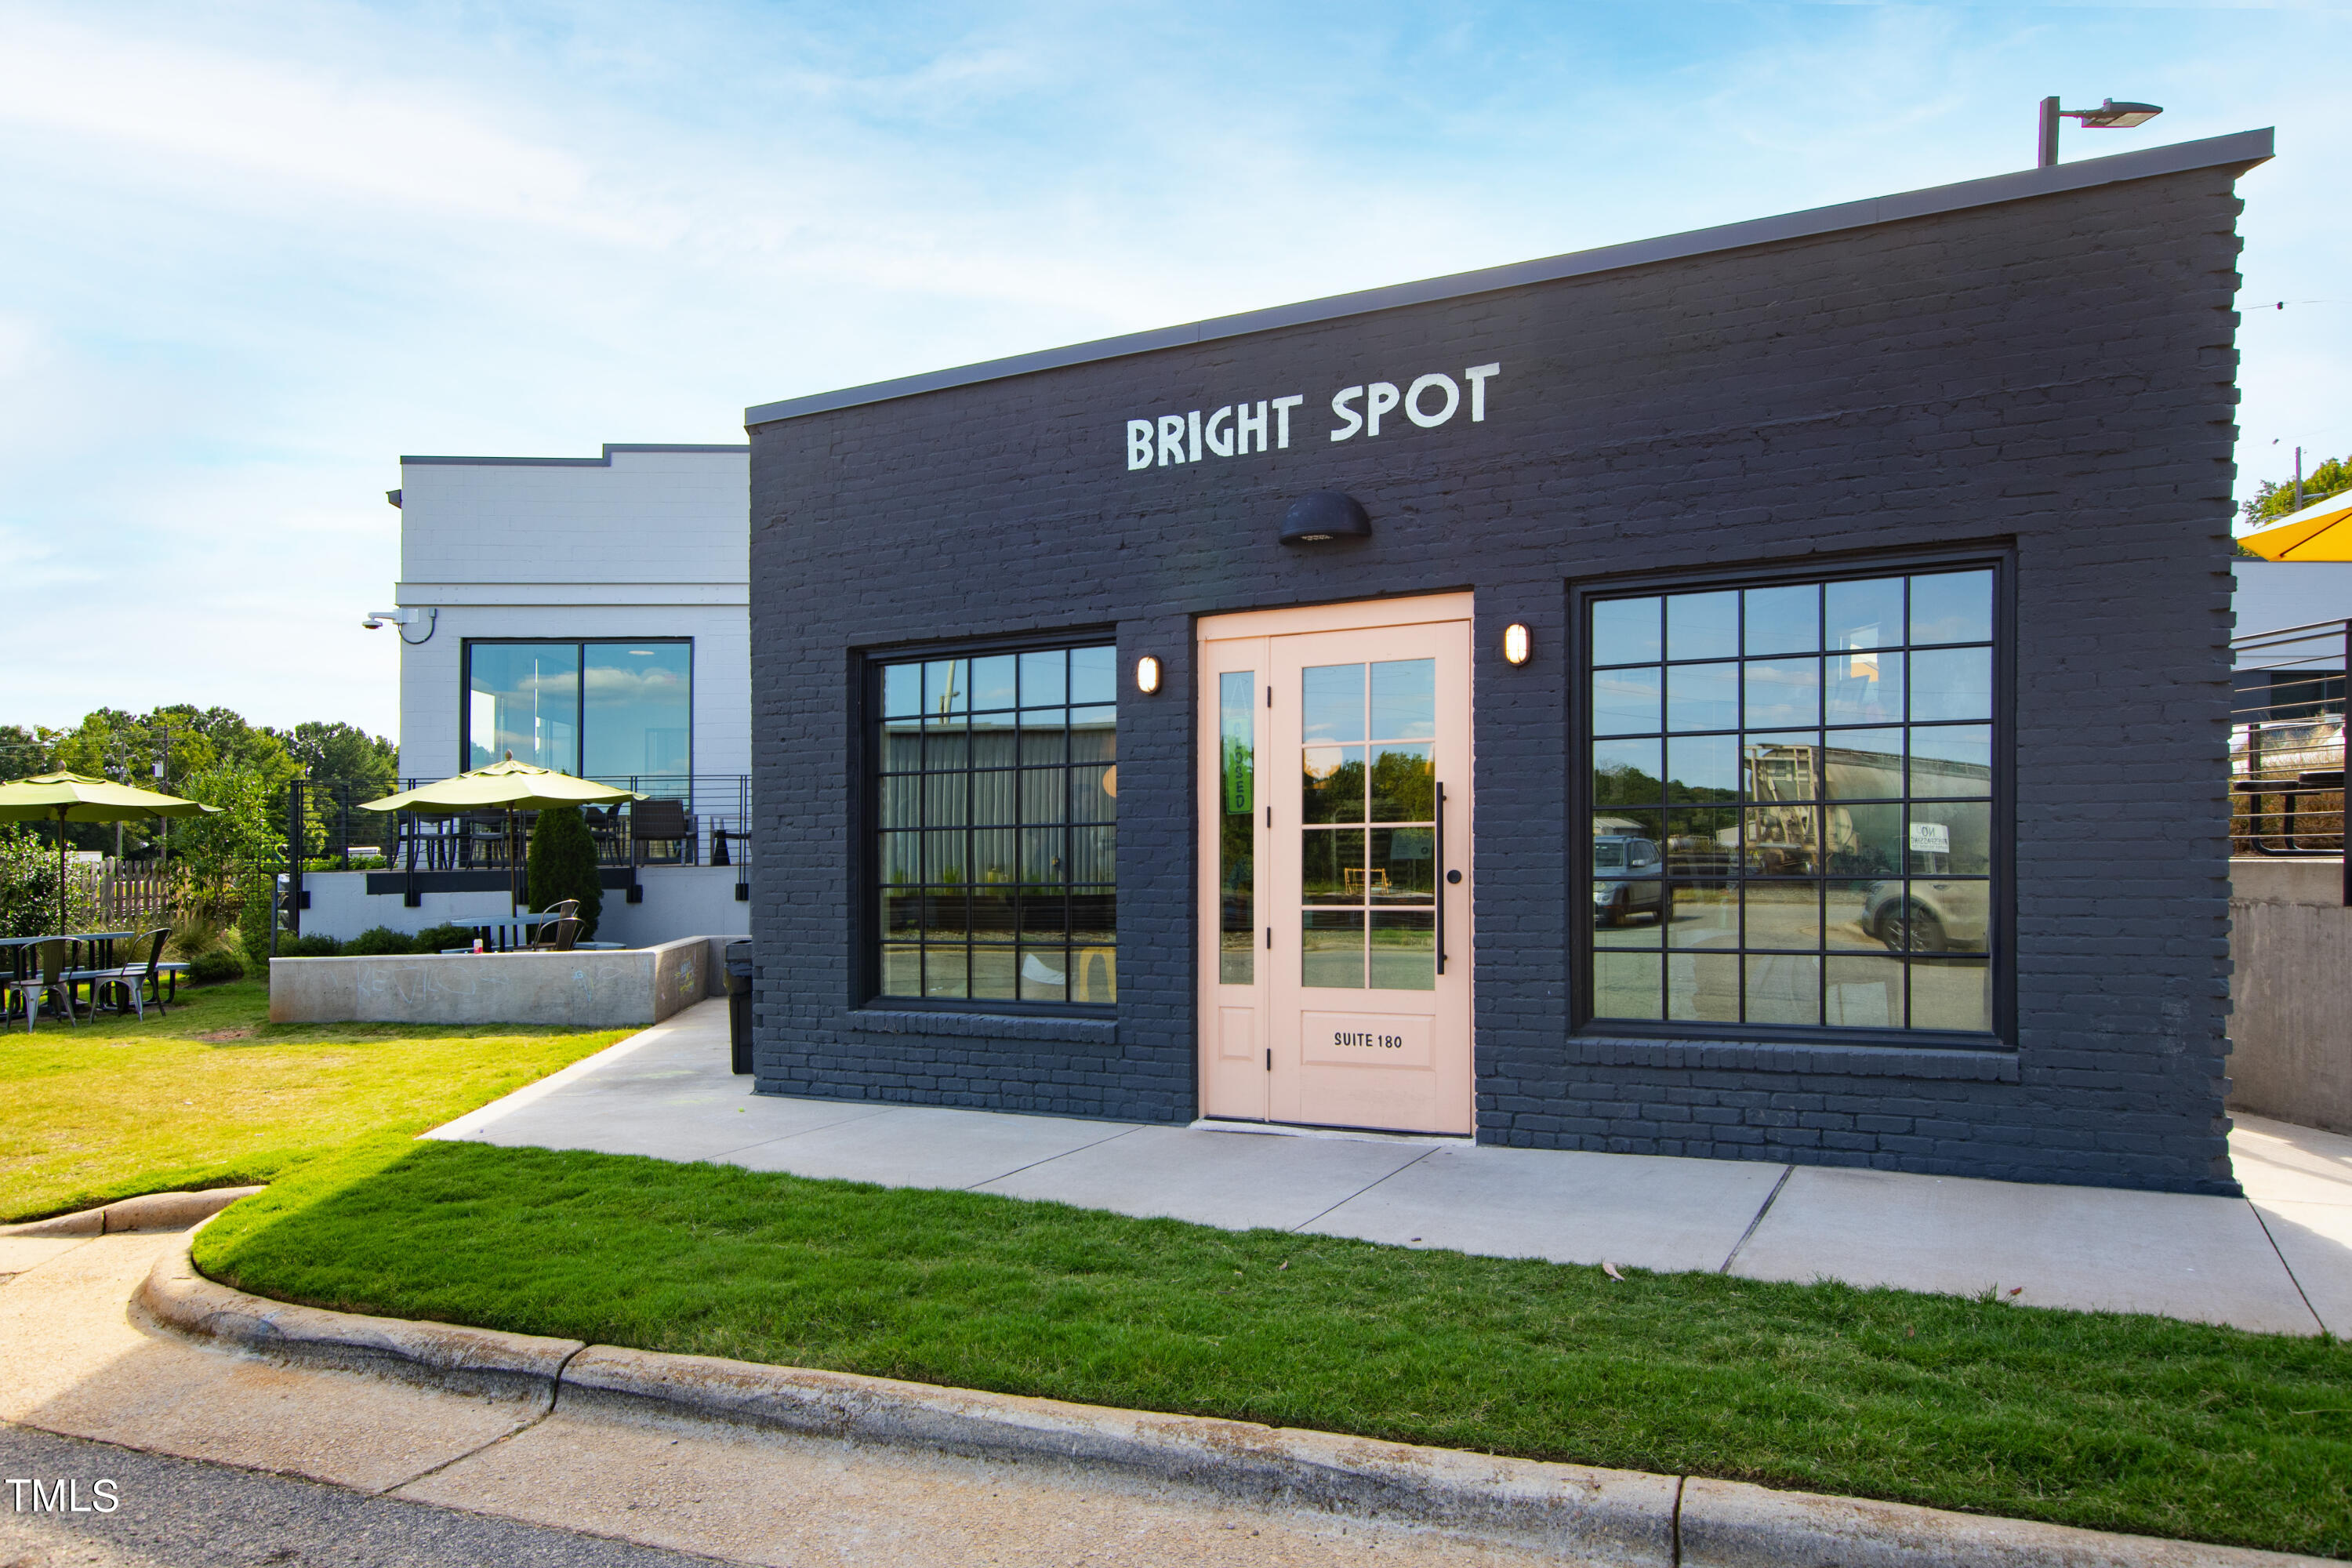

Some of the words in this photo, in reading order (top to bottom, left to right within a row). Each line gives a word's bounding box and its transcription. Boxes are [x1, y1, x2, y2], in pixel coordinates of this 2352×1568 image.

[1127, 394, 1304, 471] BRIGHT
[1330, 361, 1501, 442] SPOT
[1233, 721, 1246, 809] CLOSED
[1334, 1032, 1373, 1047] SUITE
[1377, 1035, 1402, 1048] 180
